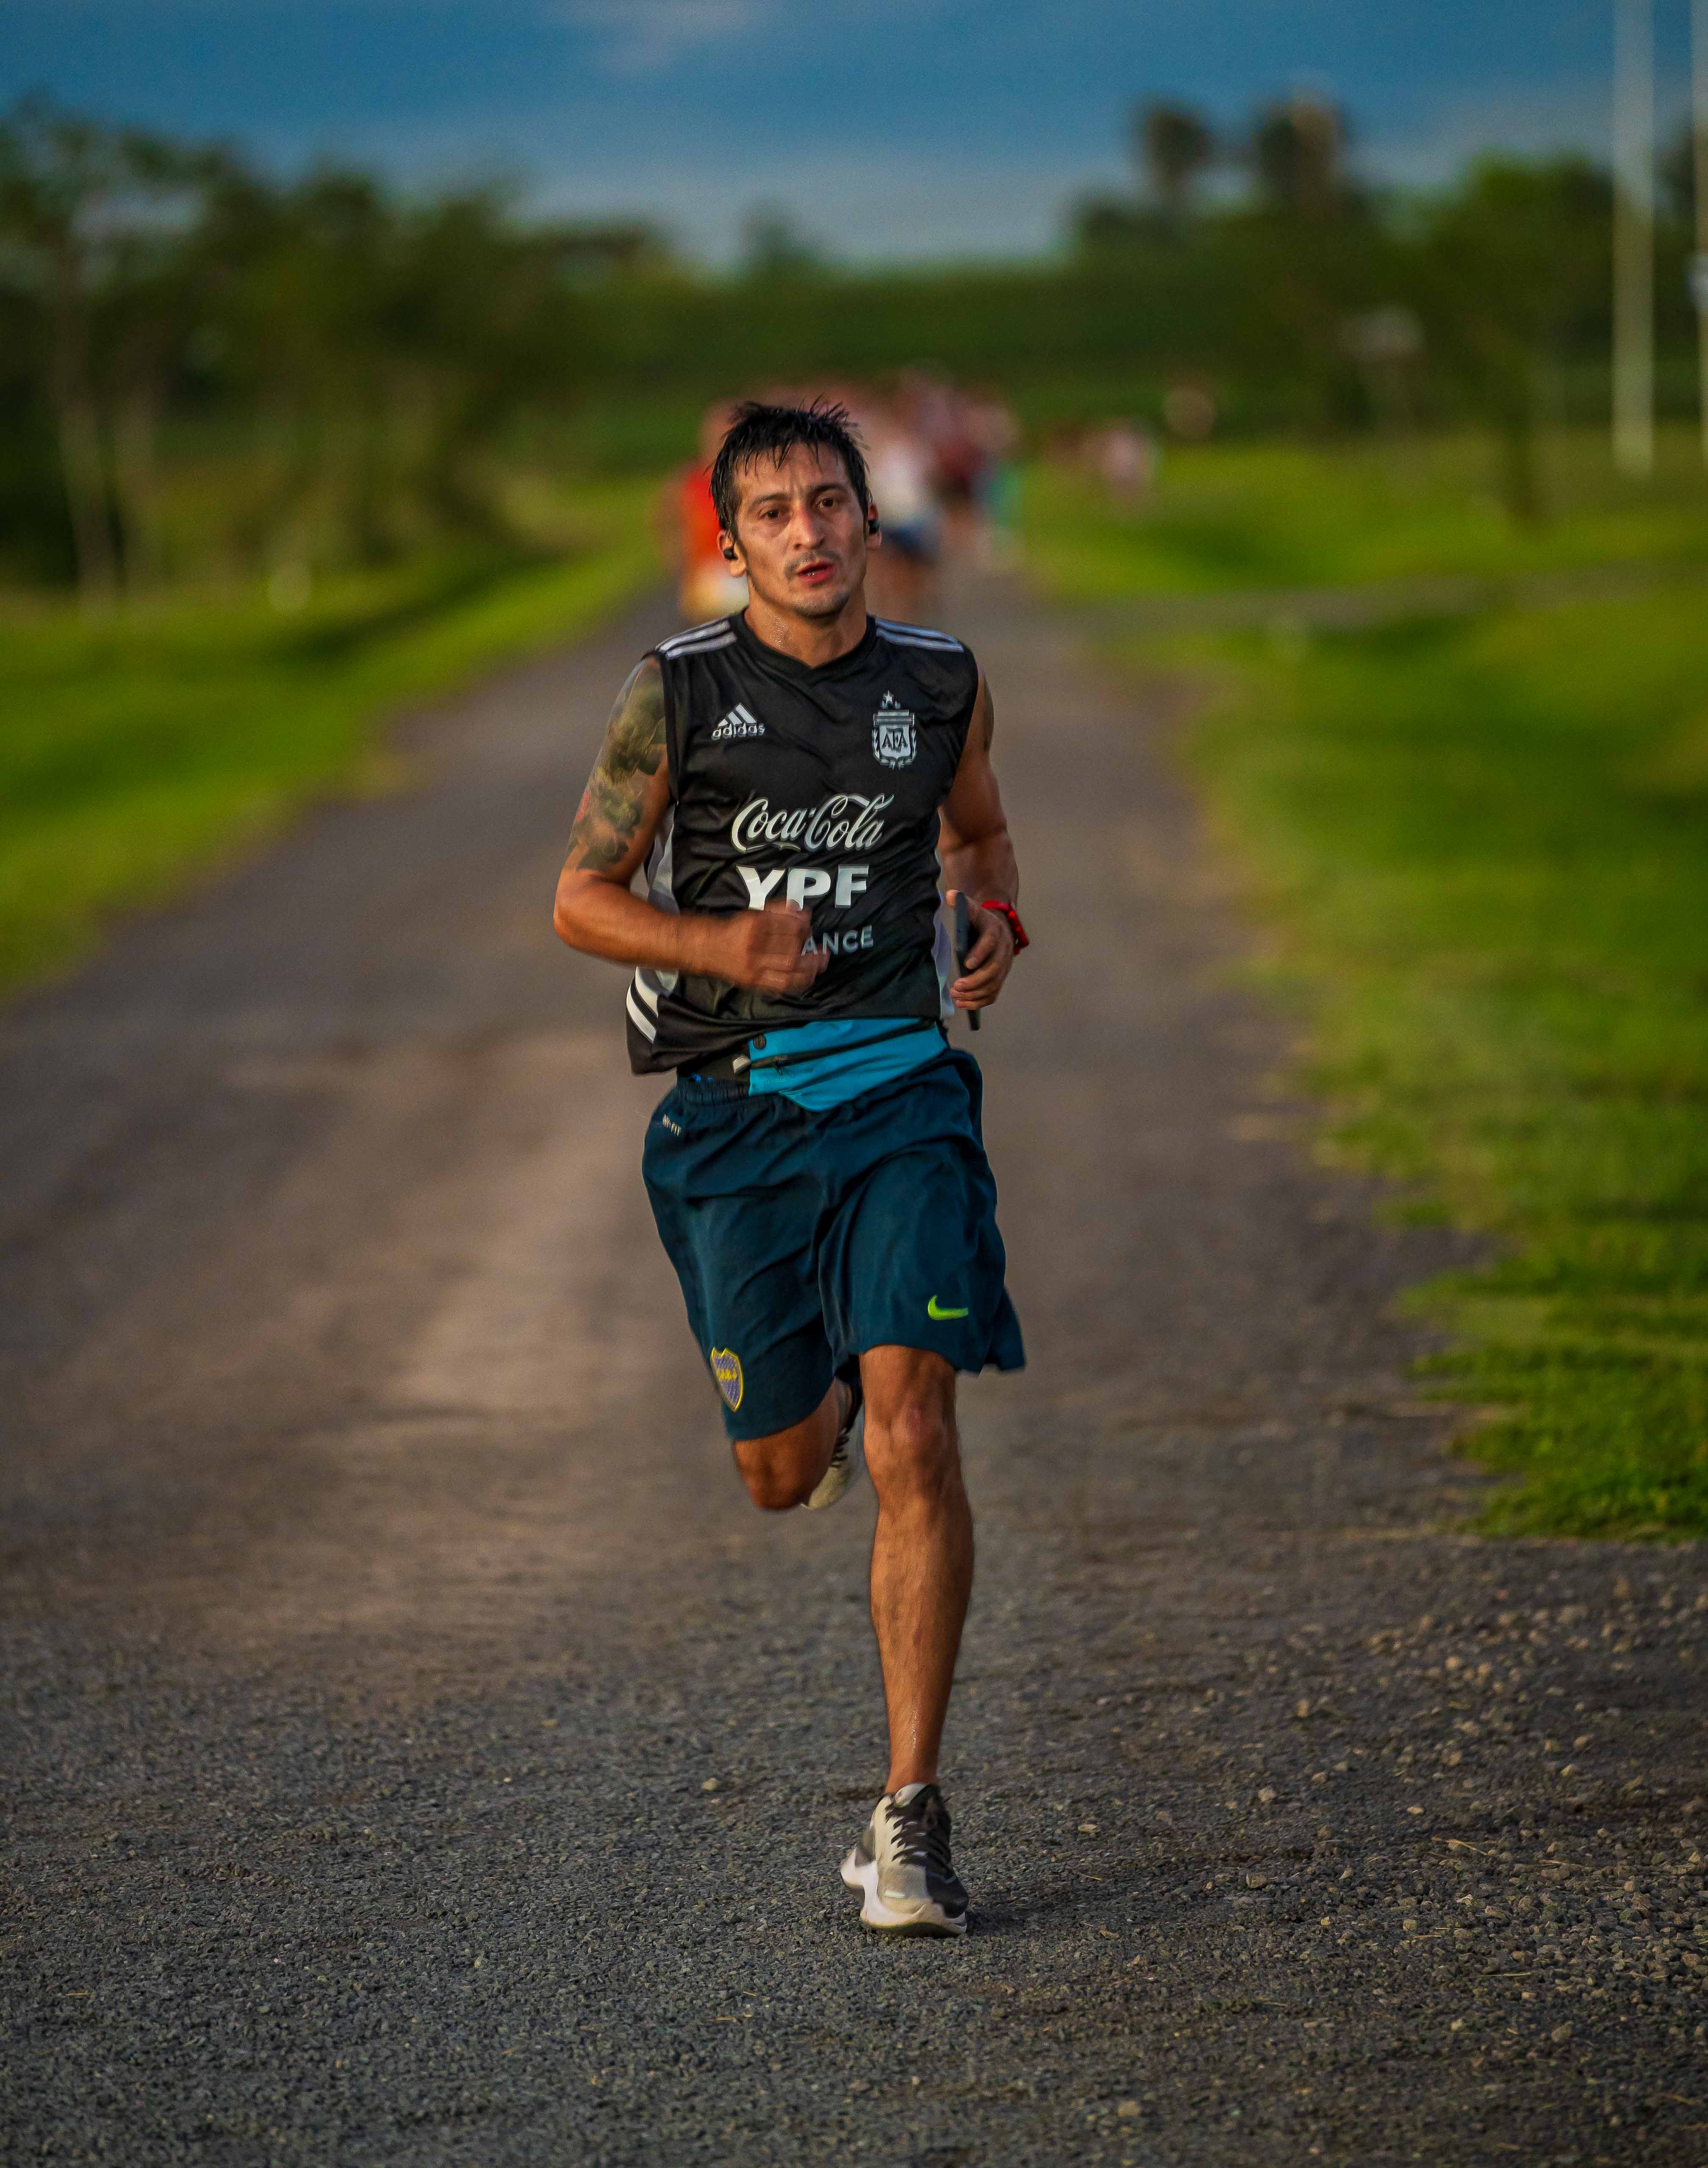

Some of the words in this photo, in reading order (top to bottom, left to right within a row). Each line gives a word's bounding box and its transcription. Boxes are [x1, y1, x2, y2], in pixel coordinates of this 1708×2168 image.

[711, 722, 765, 740] adidas
[735, 864, 870, 912] YPF
[801, 925, 874, 956] ANCE
